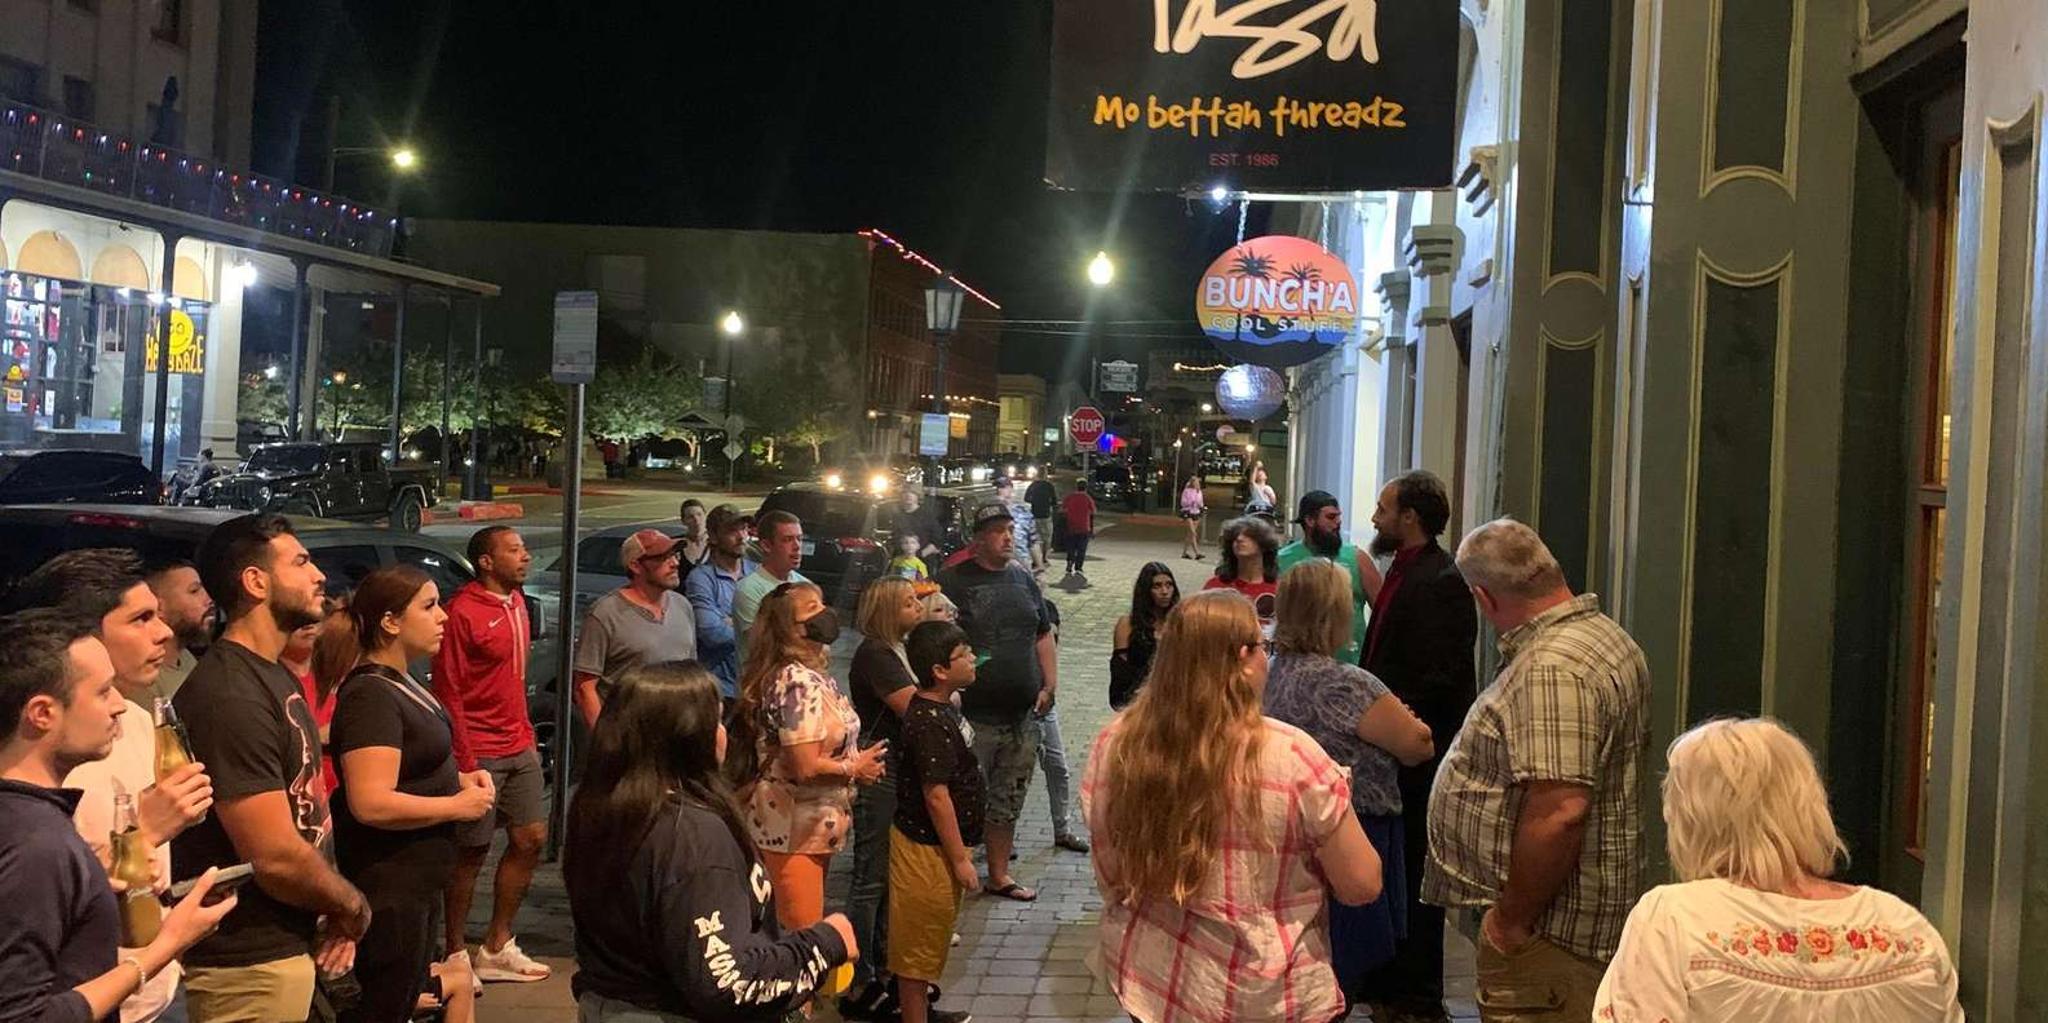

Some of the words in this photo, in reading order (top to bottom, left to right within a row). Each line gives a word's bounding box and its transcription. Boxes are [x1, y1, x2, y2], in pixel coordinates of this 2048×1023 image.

[1094, 95, 1139, 128] Mo
[1147, 95, 1261, 137] bettah
[1270, 96, 1406, 137] threadz
[1204, 276, 1355, 313] BUNCH'A
[1211, 316, 1266, 331] COOL
[1278, 319, 1341, 333] STUFF
[1072, 418, 1102, 432] STOP
